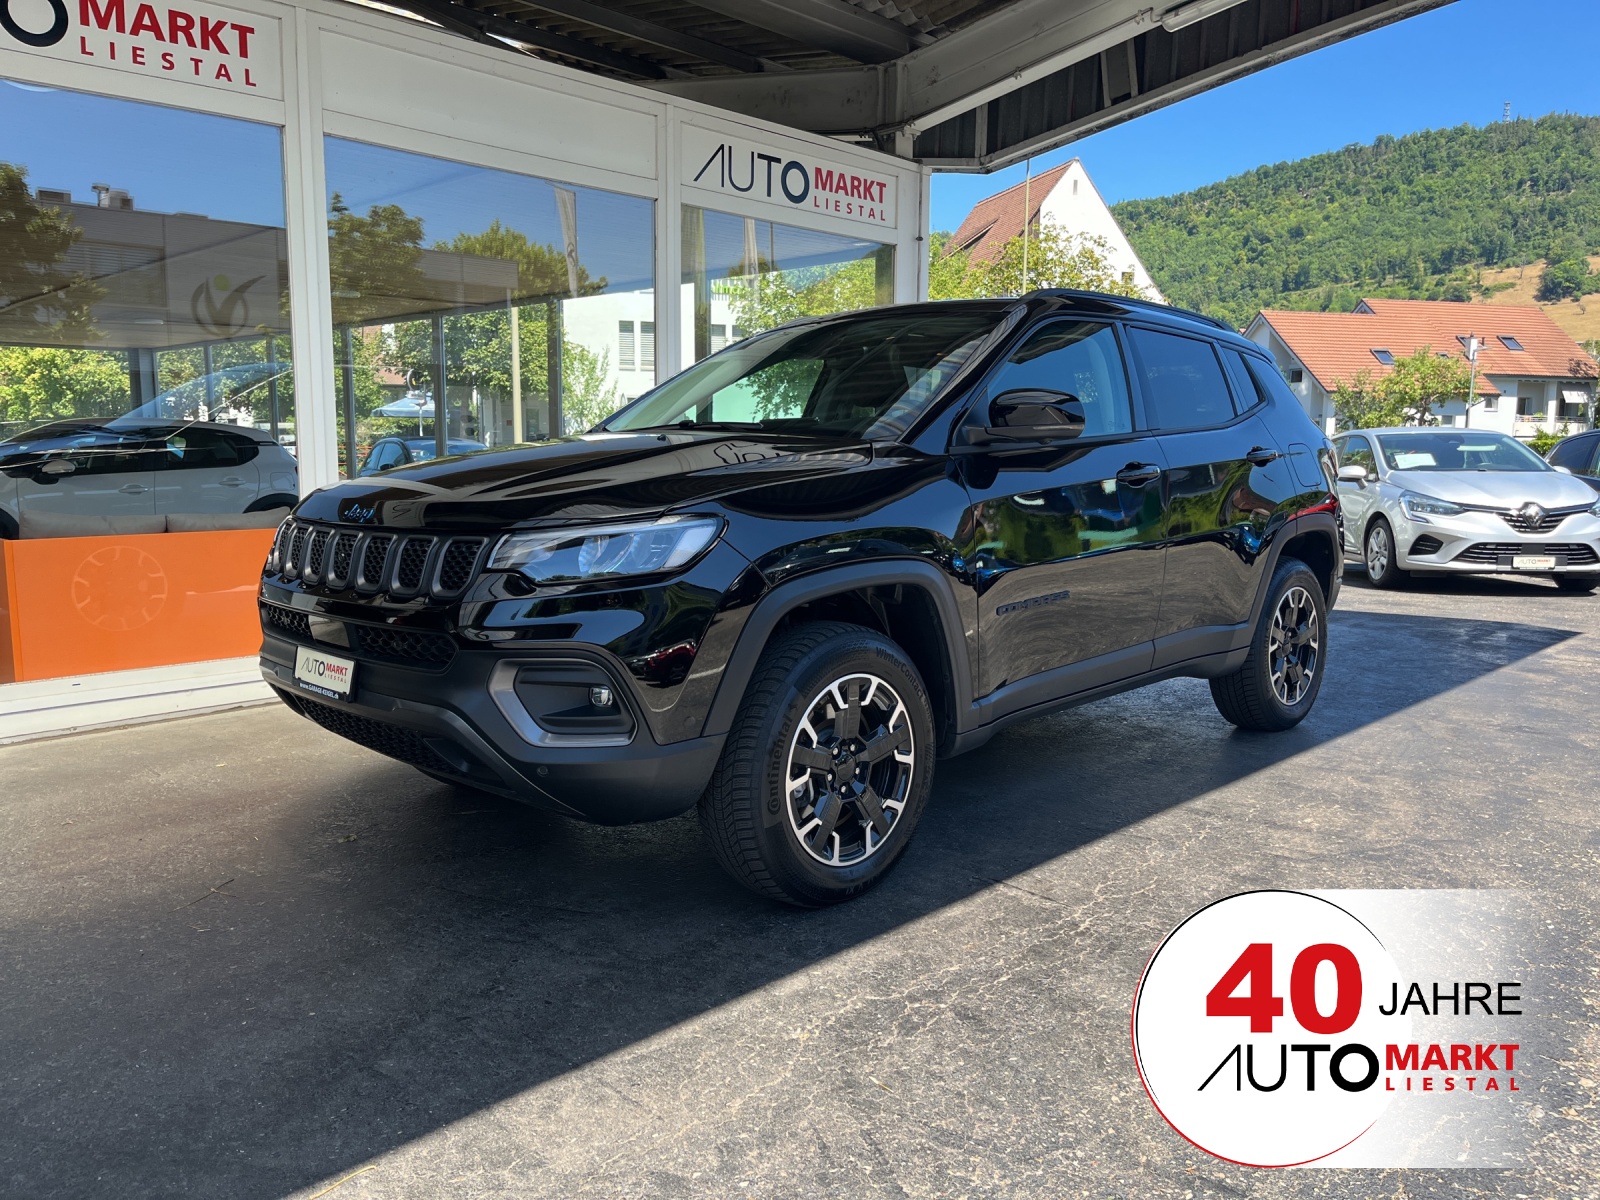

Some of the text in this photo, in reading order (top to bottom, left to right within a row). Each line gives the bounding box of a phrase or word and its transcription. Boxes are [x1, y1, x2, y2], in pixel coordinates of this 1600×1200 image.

[79, 0, 255, 59] MARKT
[80, 36, 257, 87] LIESTAL
[693, 143, 887, 204] AUTO MARKT
[814, 195, 886, 221] LIESTAL
[301, 657, 348, 677] AUTO MARKT
[767, 714, 793, 816] Continental
